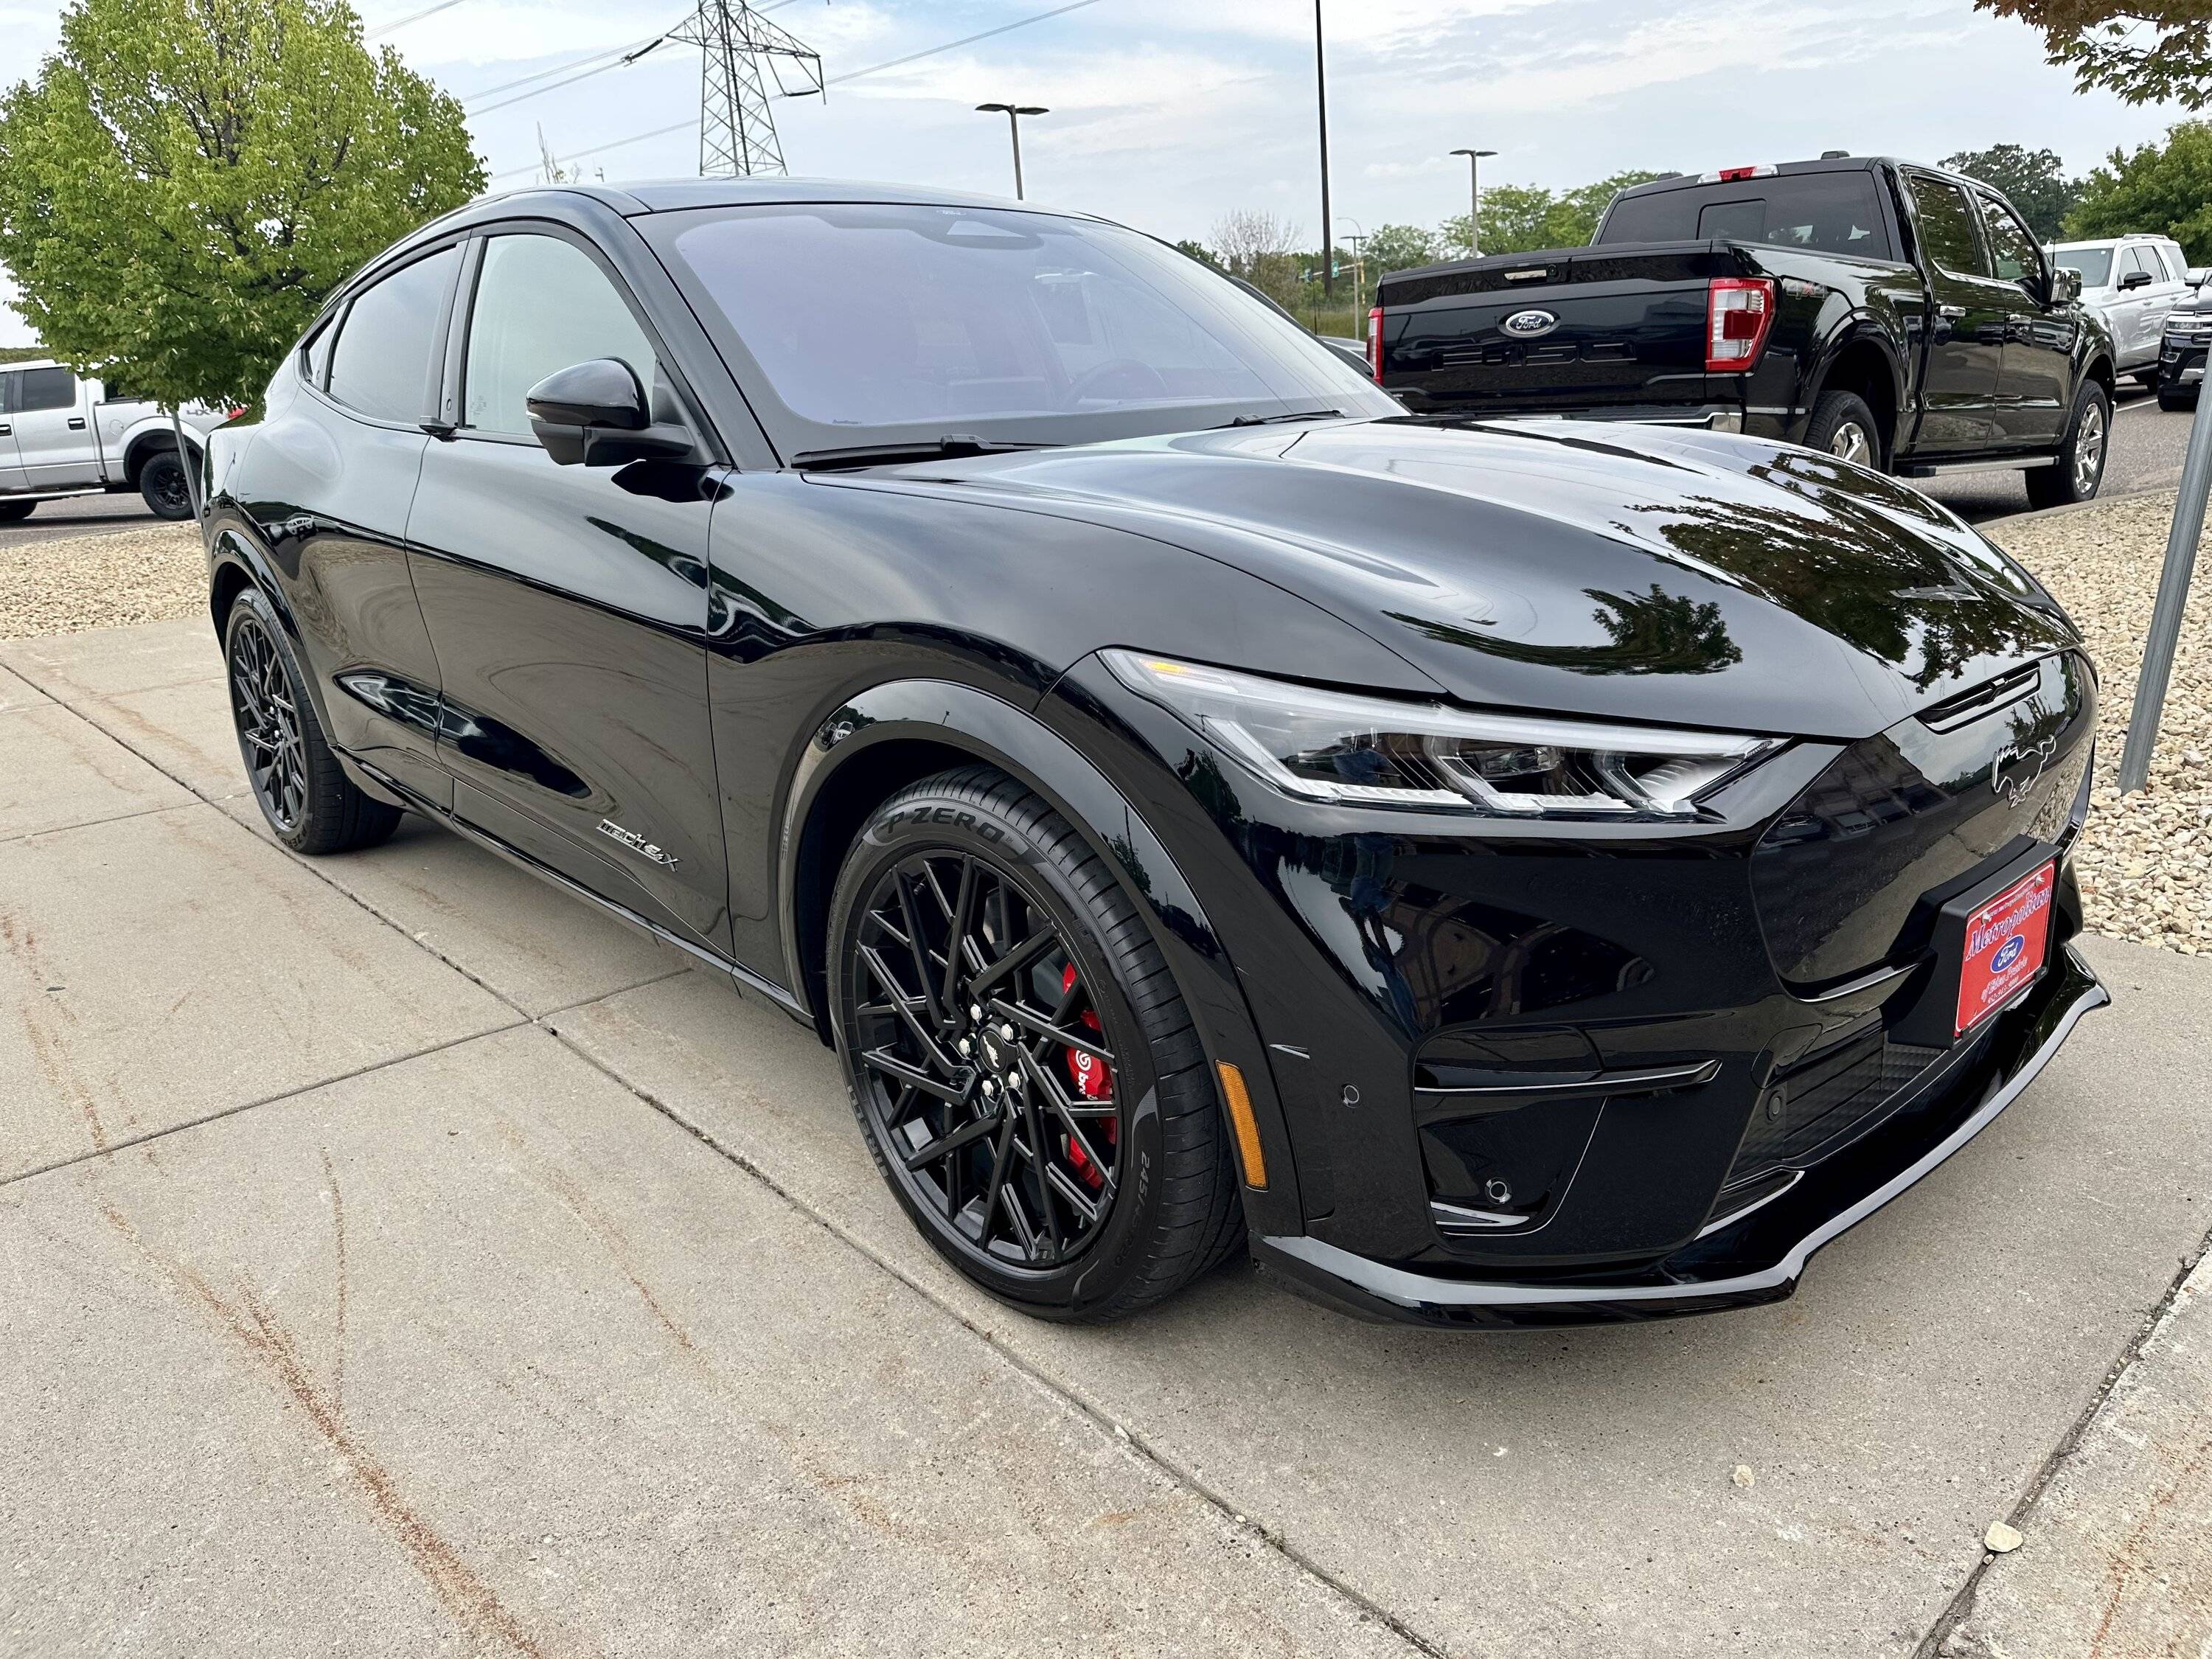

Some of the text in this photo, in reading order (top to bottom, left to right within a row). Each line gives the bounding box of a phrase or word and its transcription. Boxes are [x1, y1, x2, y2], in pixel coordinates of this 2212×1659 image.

[1516, 316, 1543, 330] Ford
[888, 811, 905, 834] P
[911, 807, 1005, 844] ZERO
[1965, 886, 2051, 961] Metropolitan
[1997, 942, 2019, 967] Ford
